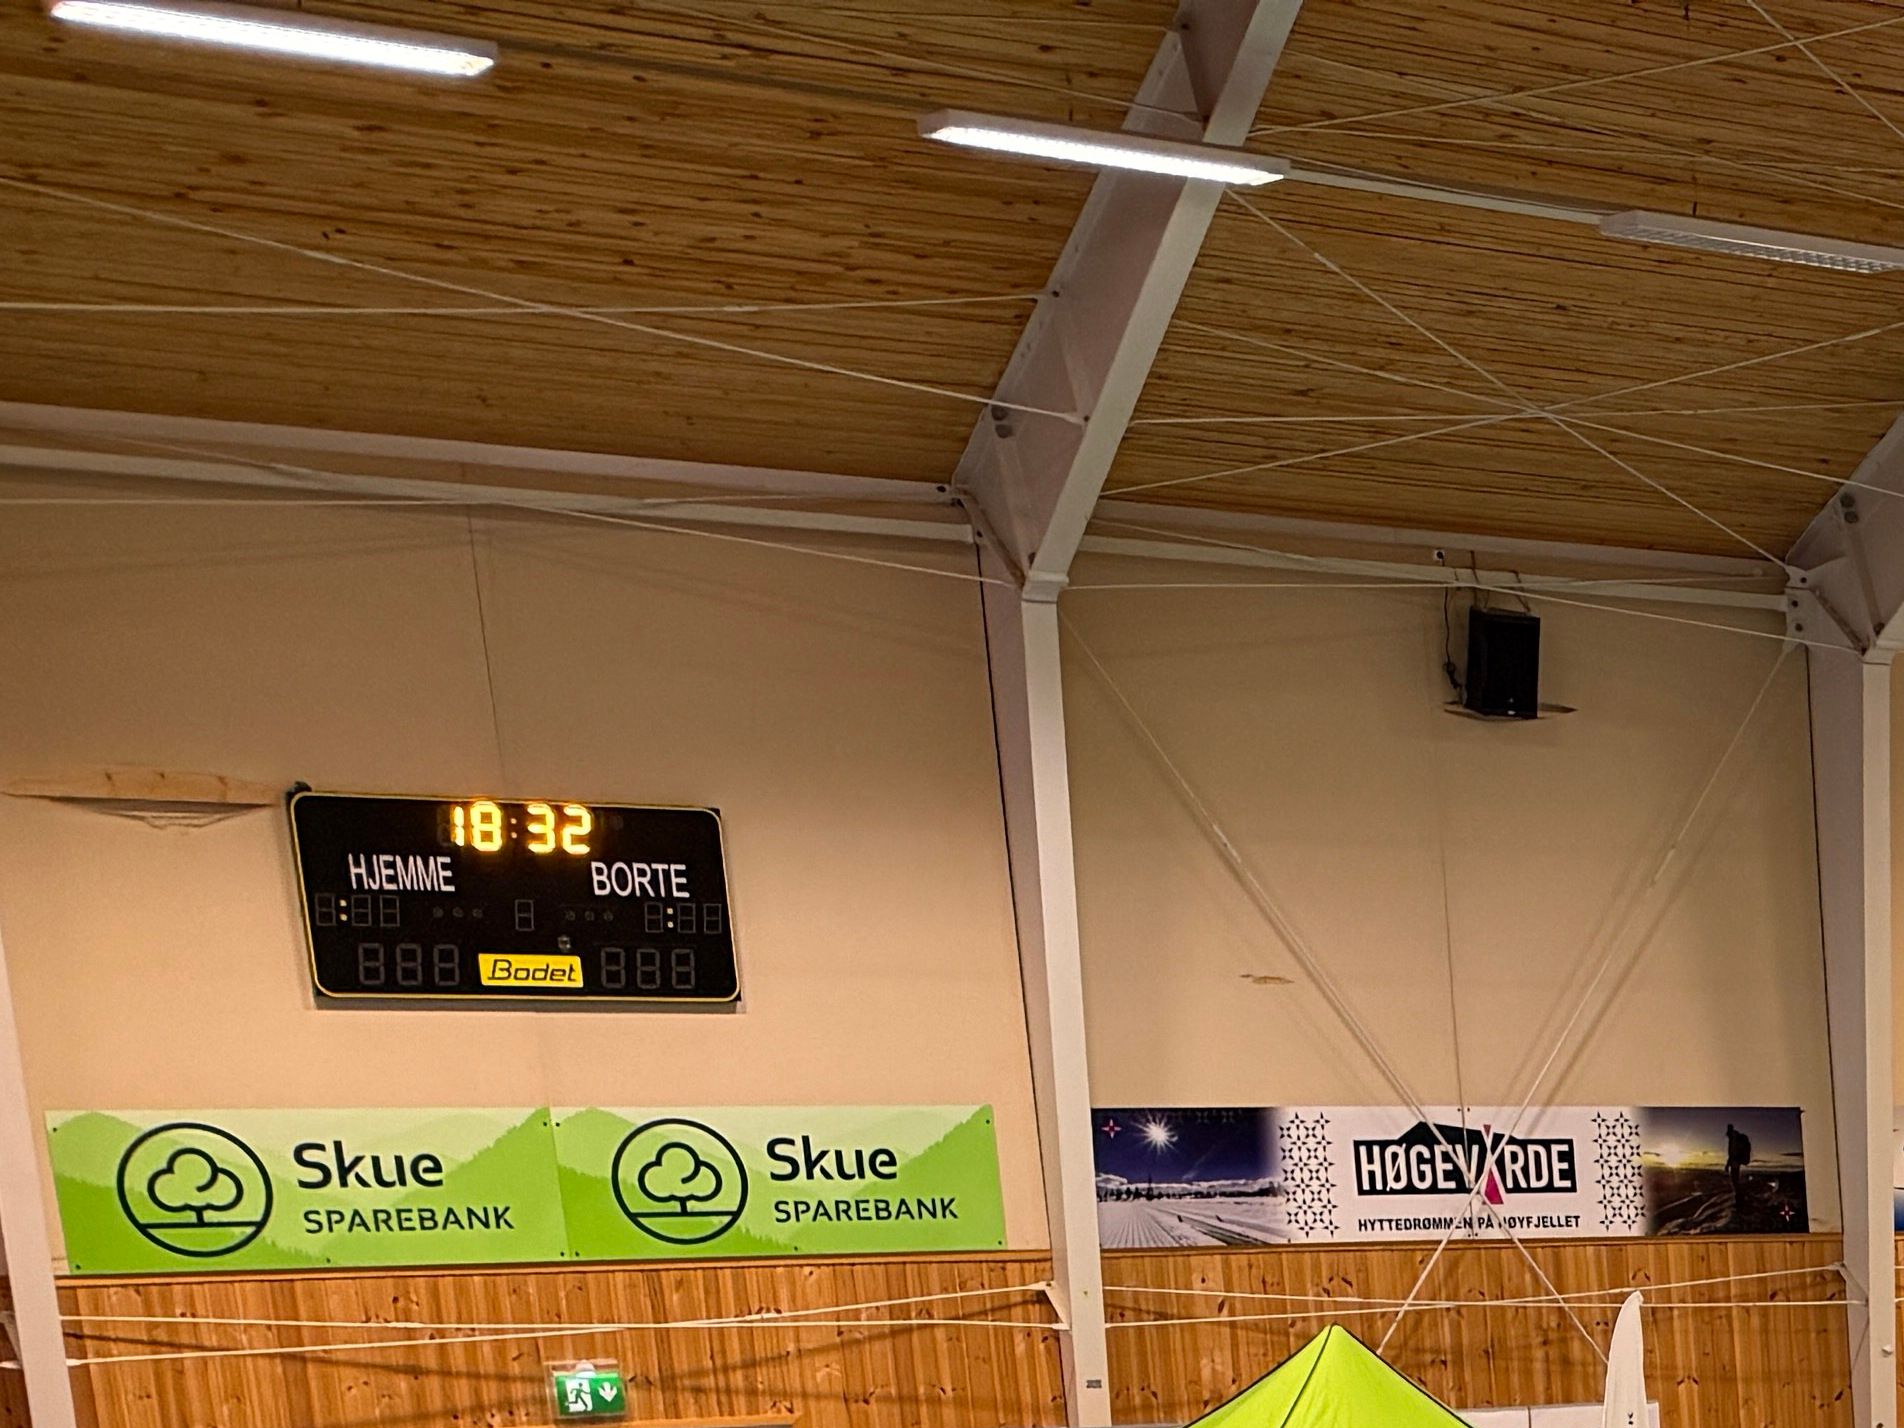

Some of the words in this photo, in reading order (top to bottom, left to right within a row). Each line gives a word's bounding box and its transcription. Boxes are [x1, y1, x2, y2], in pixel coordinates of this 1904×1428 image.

[348, 854, 456, 893] HJEMME
[592, 860, 690, 899] BORTE
[486, 957, 578, 984] Bodet
[293, 1139, 445, 1190] Skue
[764, 1135, 899, 1182] Skue
[303, 1204, 515, 1234] SPAREBANK
[774, 1197, 958, 1223] SPAREBANK
[1477, 1213, 1493, 1230] PÅ
